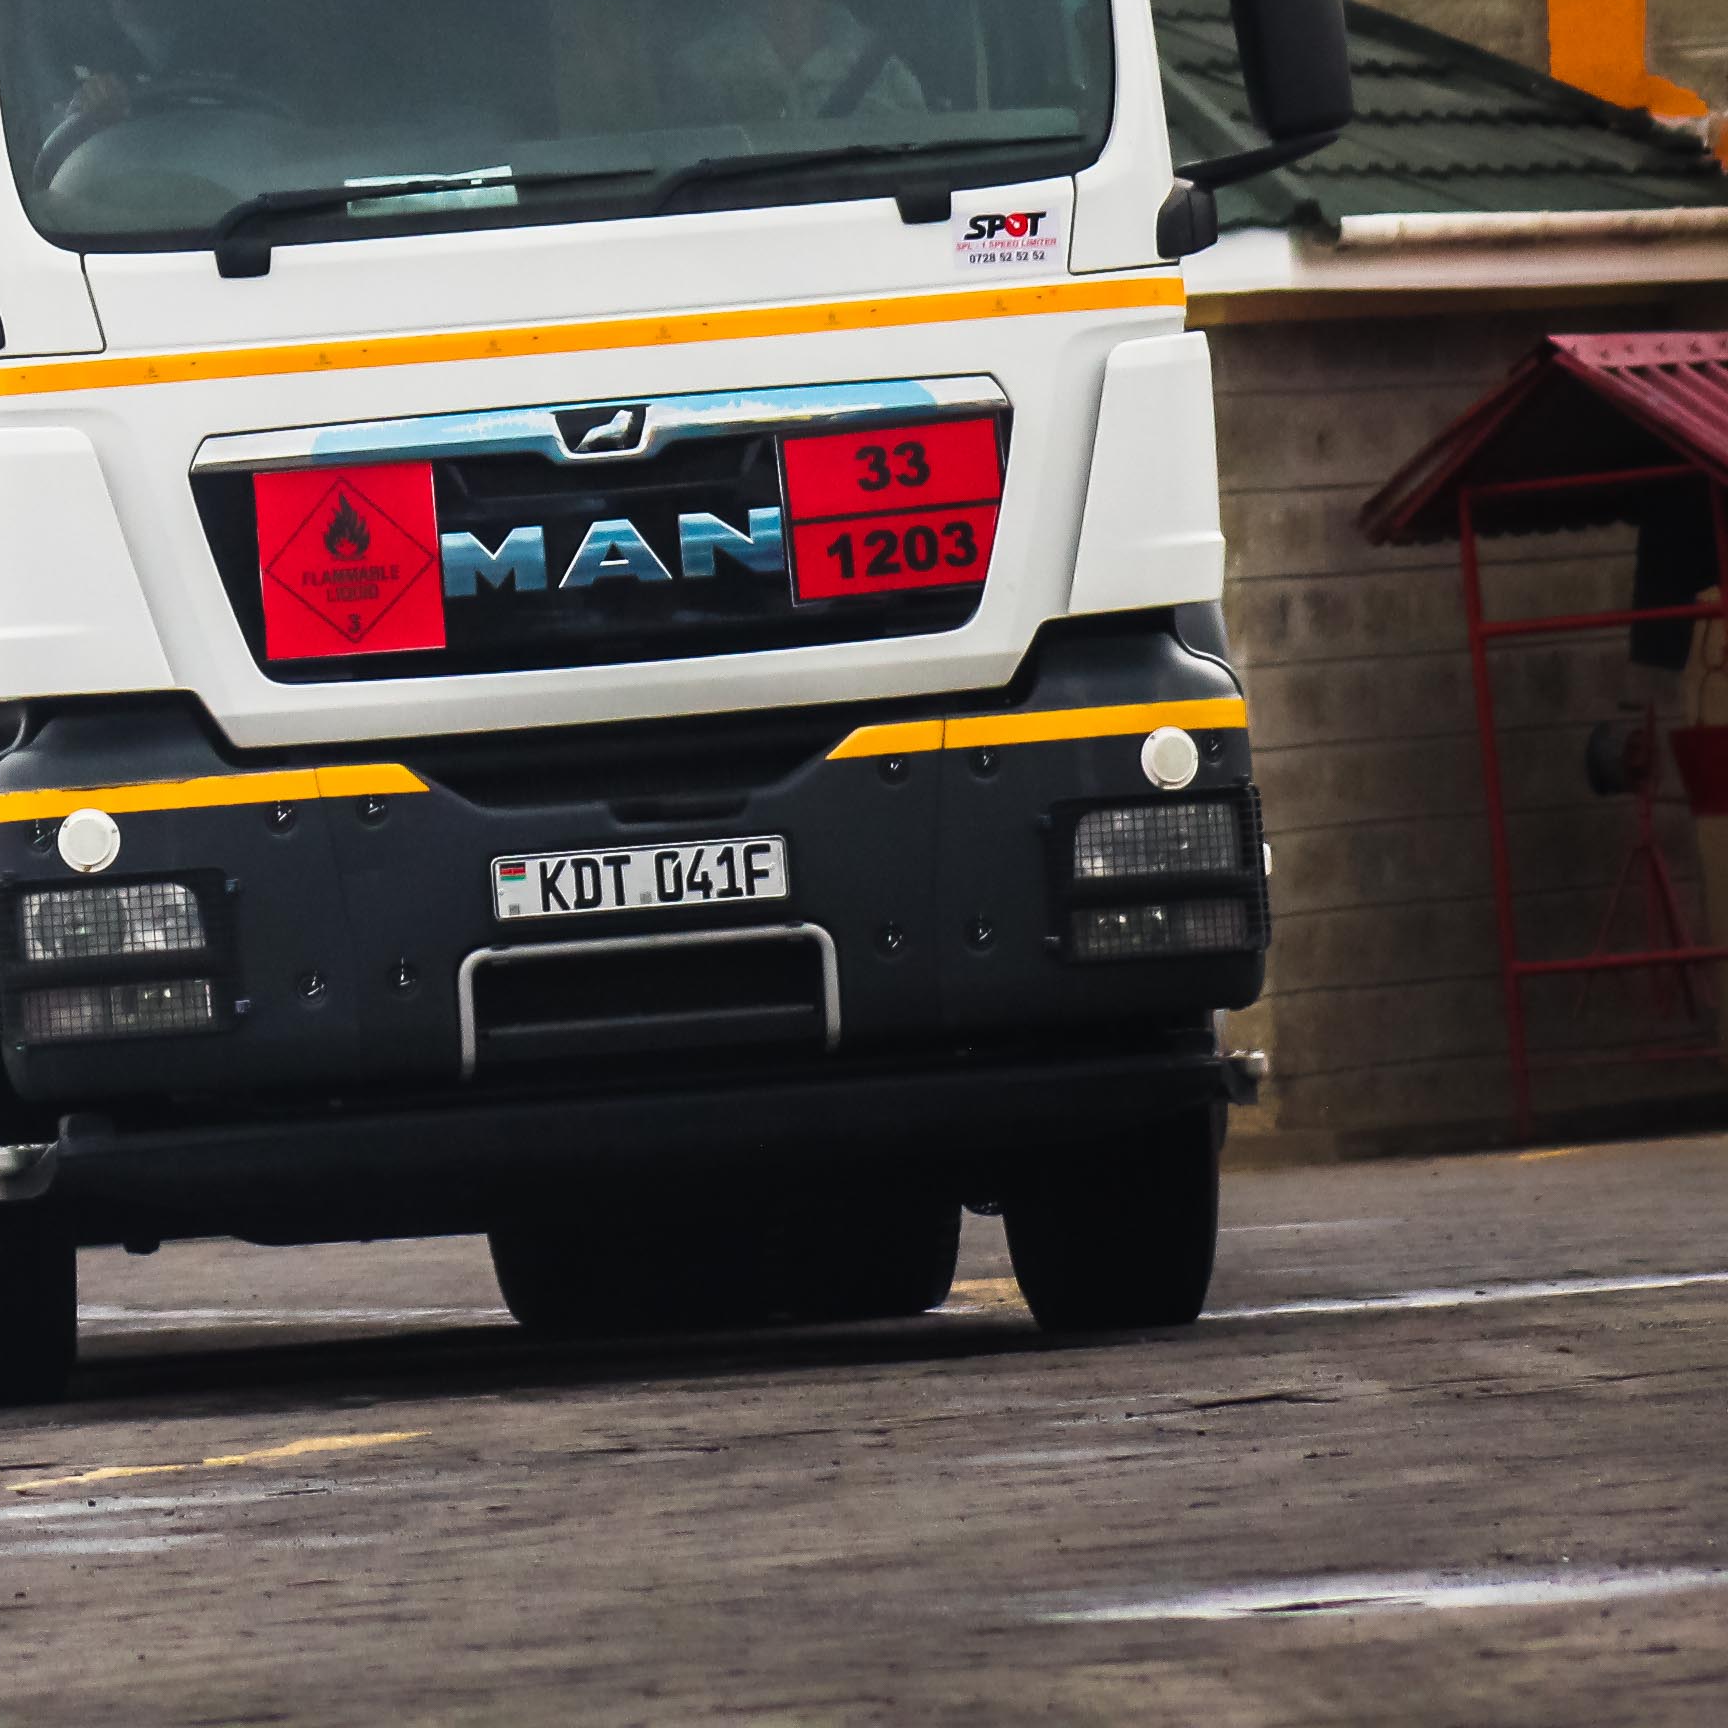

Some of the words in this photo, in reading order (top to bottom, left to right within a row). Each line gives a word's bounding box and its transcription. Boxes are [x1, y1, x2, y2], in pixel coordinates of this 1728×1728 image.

[963, 211, 1047, 240] SPOT
[989, 239, 1019, 249] SPEED
[1021, 238, 1057, 248] LIMITER
[969, 253, 996, 264] 0728
[854, 440, 932, 492] 33
[440, 506, 786, 599] MAN
[826, 521, 978, 581] 1203
[347, 613, 362, 634] 3
[538, 853, 631, 913] KDT
[654, 842, 771, 903] 041F
